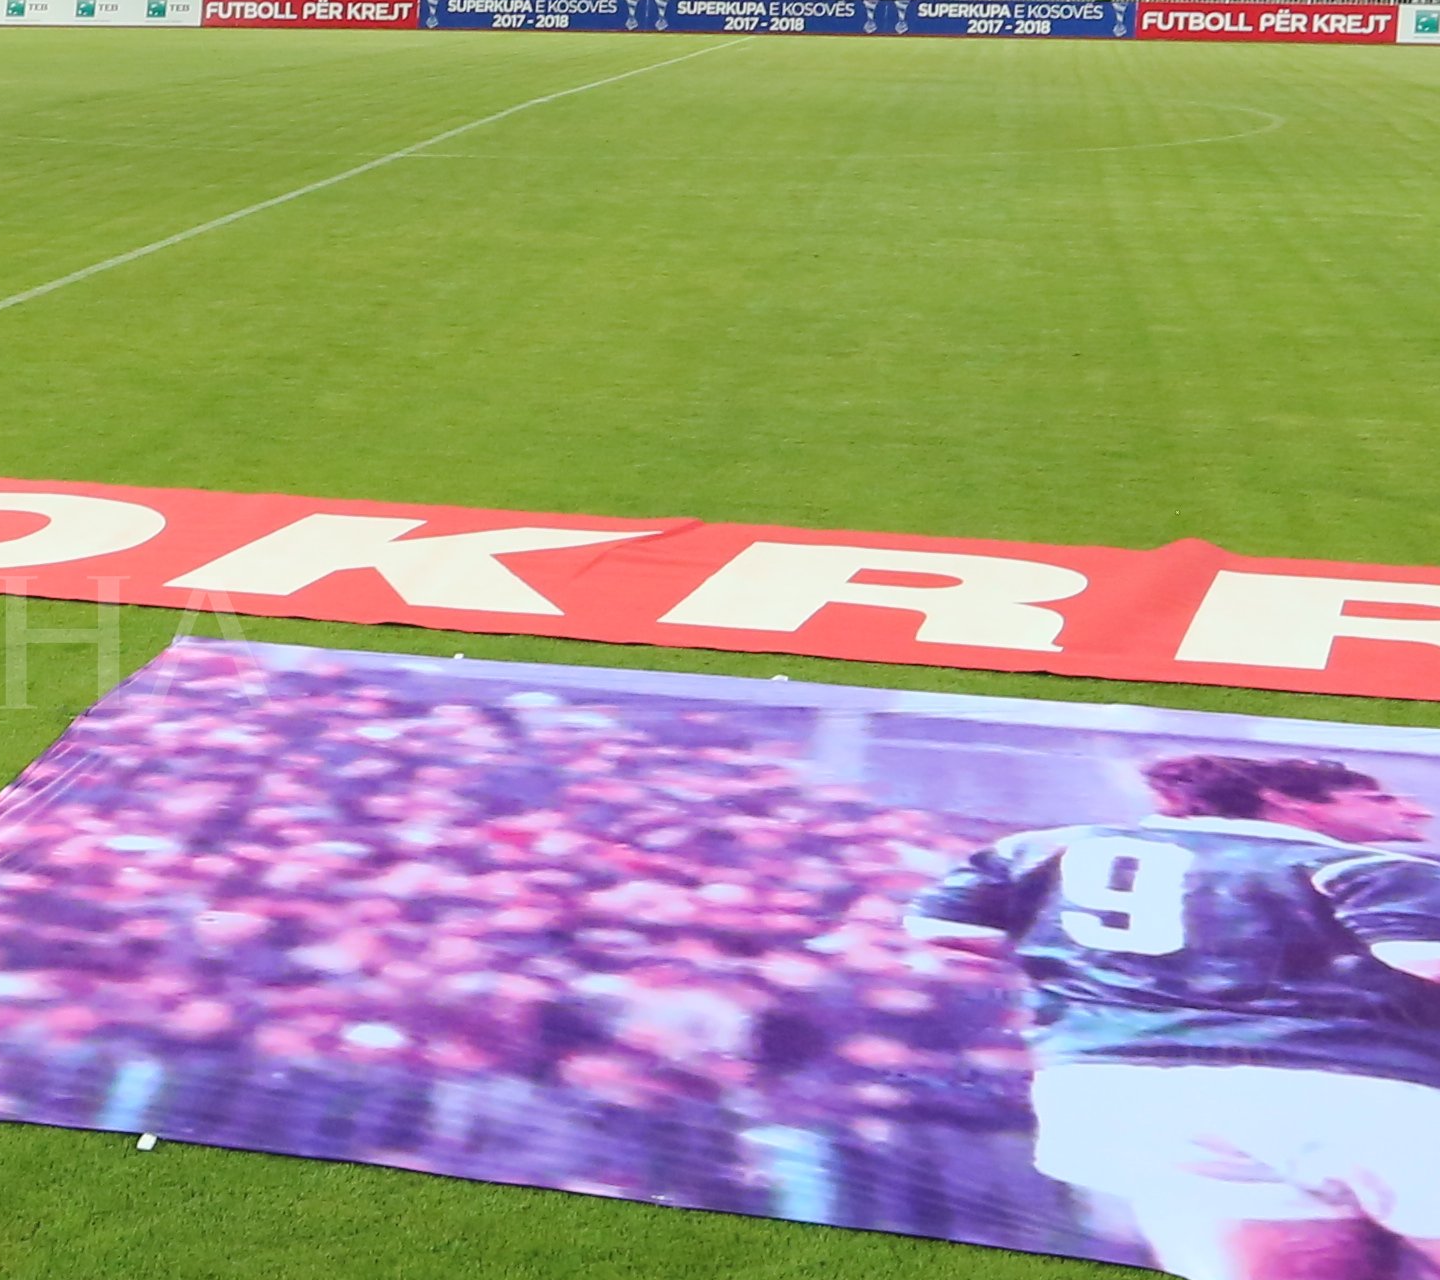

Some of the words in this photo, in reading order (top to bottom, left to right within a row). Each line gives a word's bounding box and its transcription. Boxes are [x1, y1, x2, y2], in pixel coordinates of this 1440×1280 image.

[28, 3, 48, 11] TEB
[170, 4, 190, 12] TEB
[205, 1, 298, 20] FUTBOLL
[347, 2, 413, 21] KREJT
[447, 0, 532, 13] SUPERKUPA
[535, 1, 546, 13] E
[677, 1, 766, 16] SUPERKUPA
[770, 3, 780, 16] E
[783, 0, 855, 17] KOSOVËS
[918, 3, 1010, 18] SUPERKUPA
[1014, 4, 1024, 18] E
[1027, 2, 1103, 20] KOSOVËS
[492, 14, 524, 28] 2017
[535, 14, 569, 28] 2018
[724, 17, 757, 31] 2017
[770, 17, 804, 31] 2018
[967, 19, 1003, 34] 2017
[1014, 20, 1051, 35] 2018
[1142, 11, 1253, 32] FUTBOLL
[1259, 9, 1307, 33] PËR
[1312, 13, 1391, 35] KREJT
[1060, 834, 1195, 955] 9
